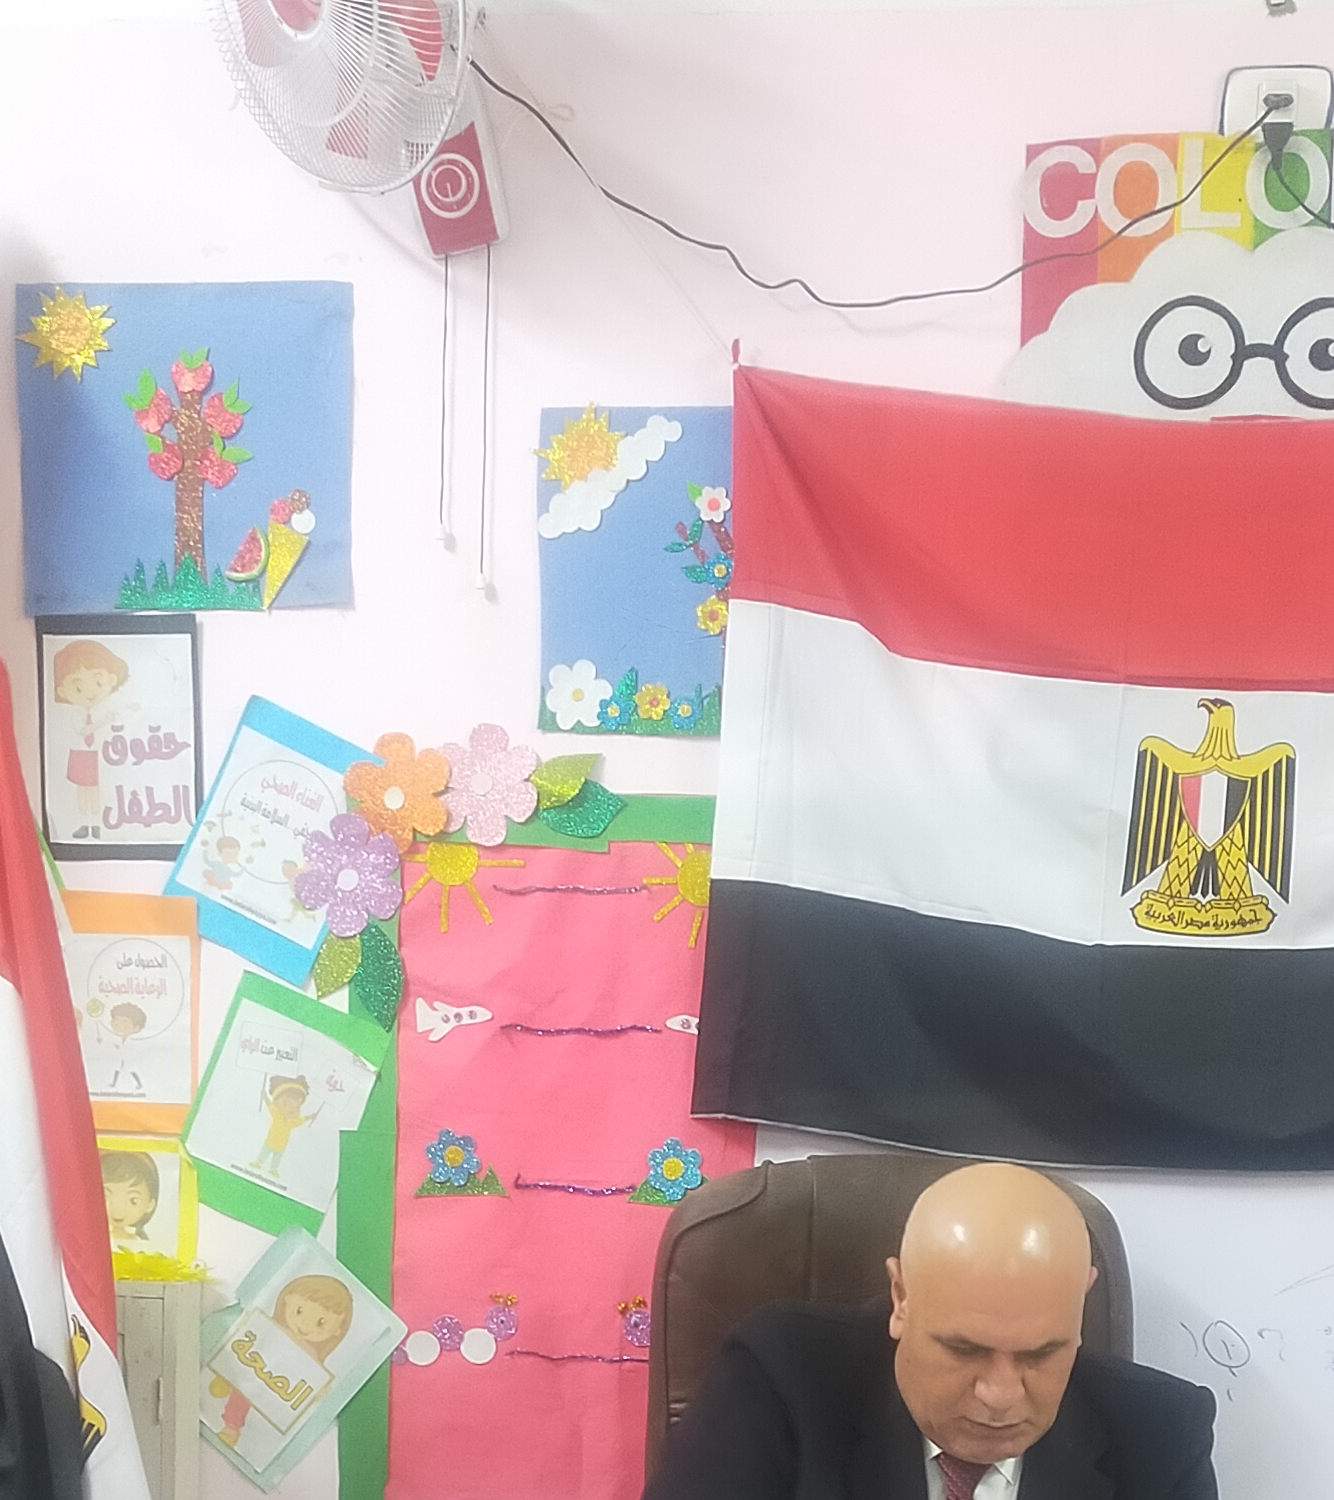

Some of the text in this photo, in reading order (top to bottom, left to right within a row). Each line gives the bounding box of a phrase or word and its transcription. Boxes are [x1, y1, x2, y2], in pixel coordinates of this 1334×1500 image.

[102, 724, 192, 766] حقوق
[102, 784, 194, 830] الطفل
[231, 1330, 314, 1411] الصحة
